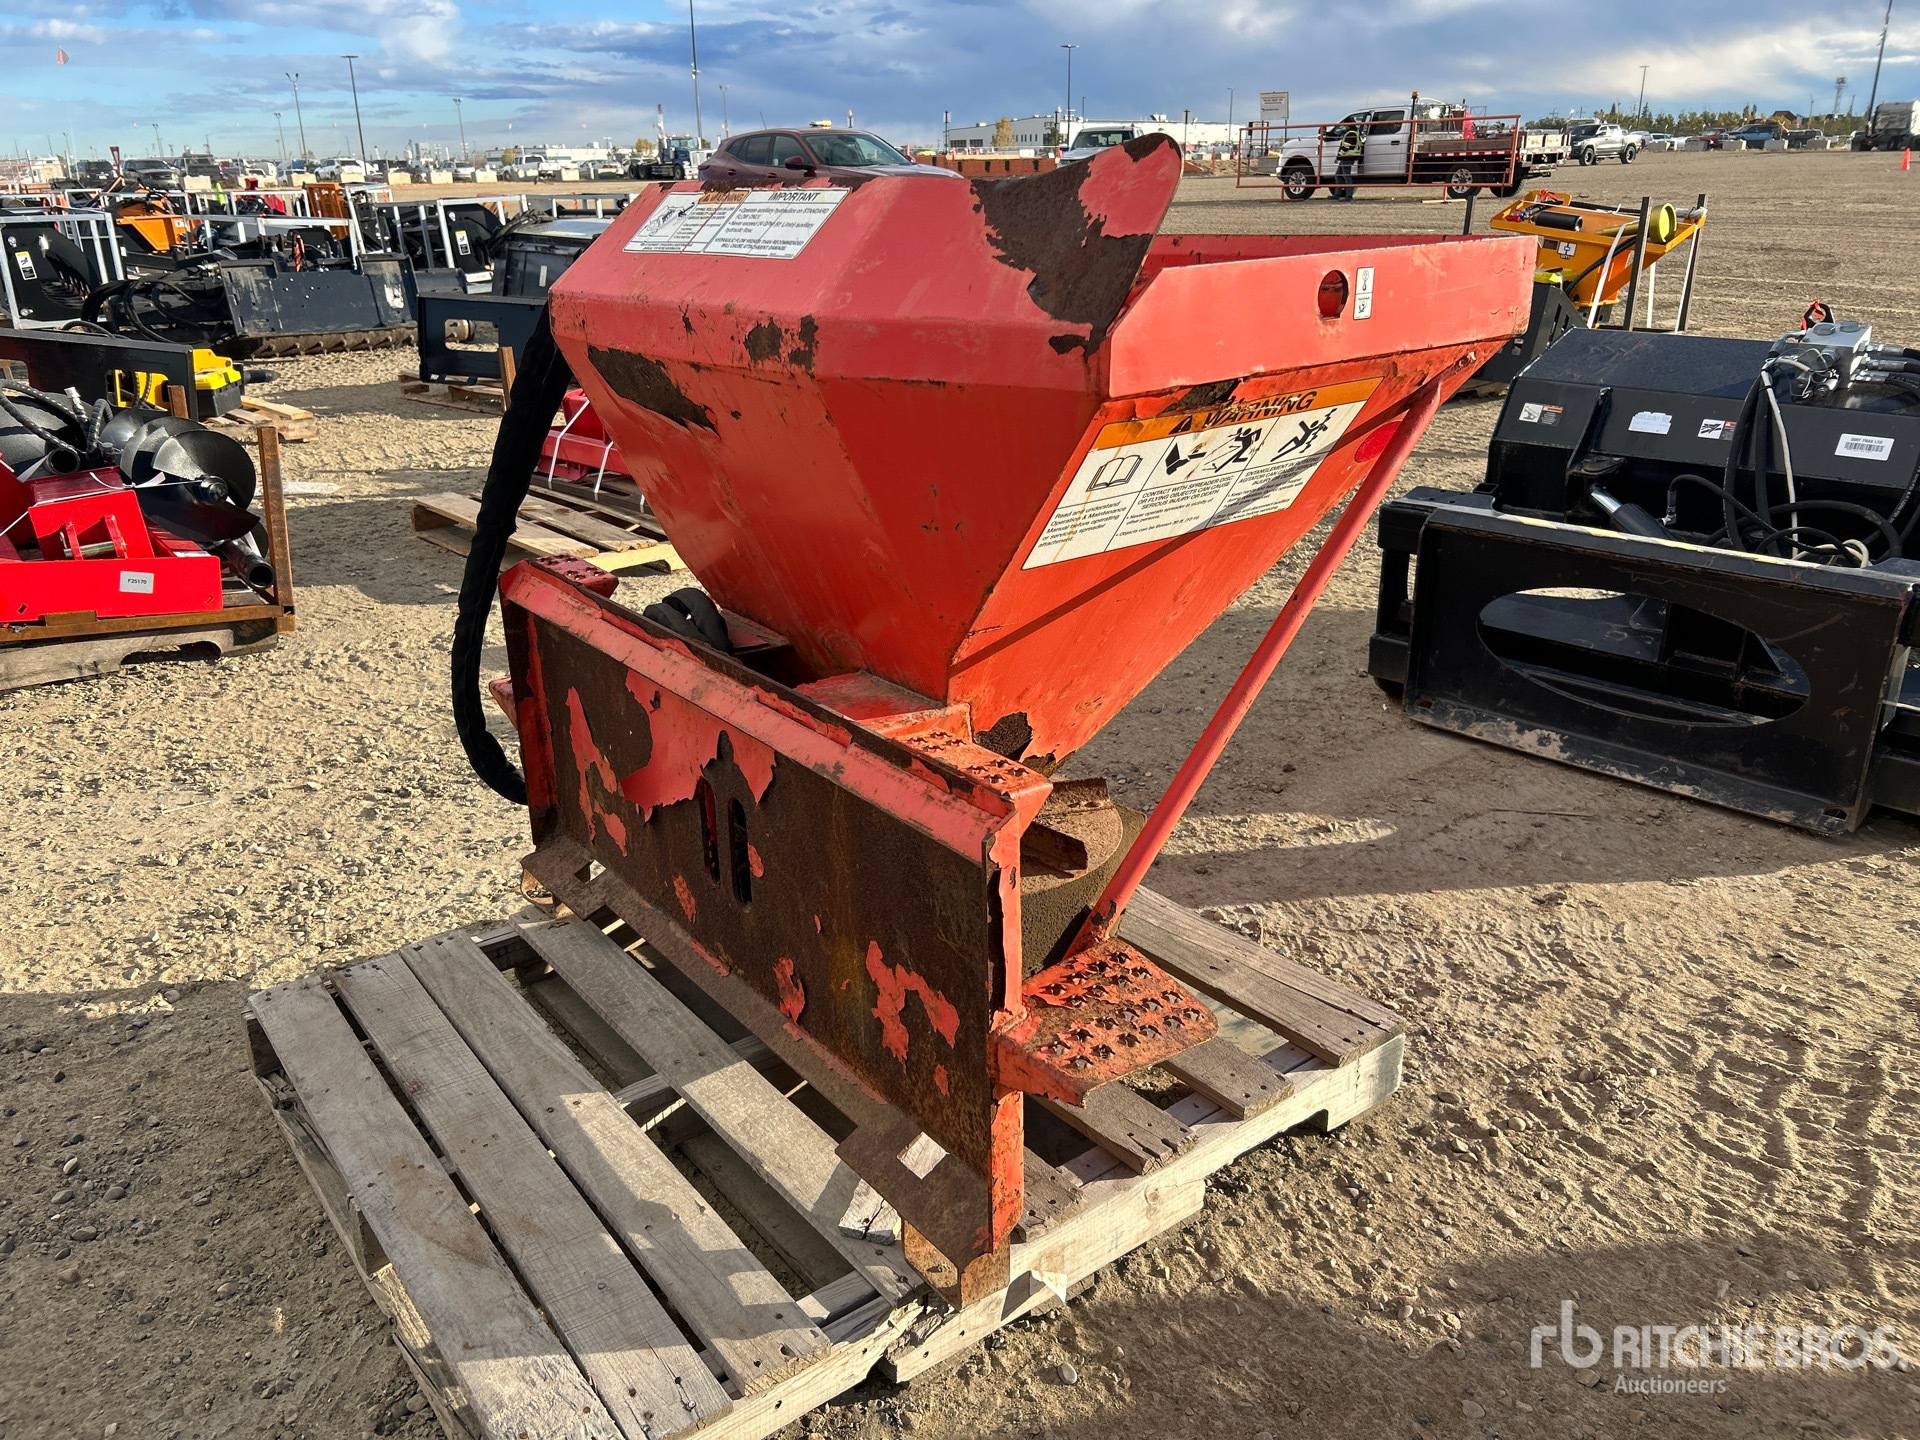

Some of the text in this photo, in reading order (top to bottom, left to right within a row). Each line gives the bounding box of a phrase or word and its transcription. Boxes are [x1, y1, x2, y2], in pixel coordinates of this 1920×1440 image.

[768, 193, 820, 201] IMPORTANT
[1202, 391, 1317, 428] WARNING
[1239, 474, 1265, 483] AGITATOR
[1246, 463, 1289, 477] ENTANGLEMENT
[1142, 488, 1171, 498] CONTACT
[1188, 478, 1220, 489] SPREADER
[1148, 494, 1169, 503] FLYING
[1170, 489, 1197, 499] OBJECTS
[1211, 482, 1230, 490] CAUSE
[1086, 501, 1121, 513] understand
[1141, 501, 1168, 509] SERIOUS
[1169, 496, 1190, 504] INJURY
[1200, 489, 1220, 497] DEATH
[1046, 515, 1120, 534] Manual before operating
[1051, 516, 1080, 527] Operation
[1088, 507, 1127, 518] Maintenance
[1050, 530, 1078, 539] servicing
[1079, 524, 1106, 533] spreader
